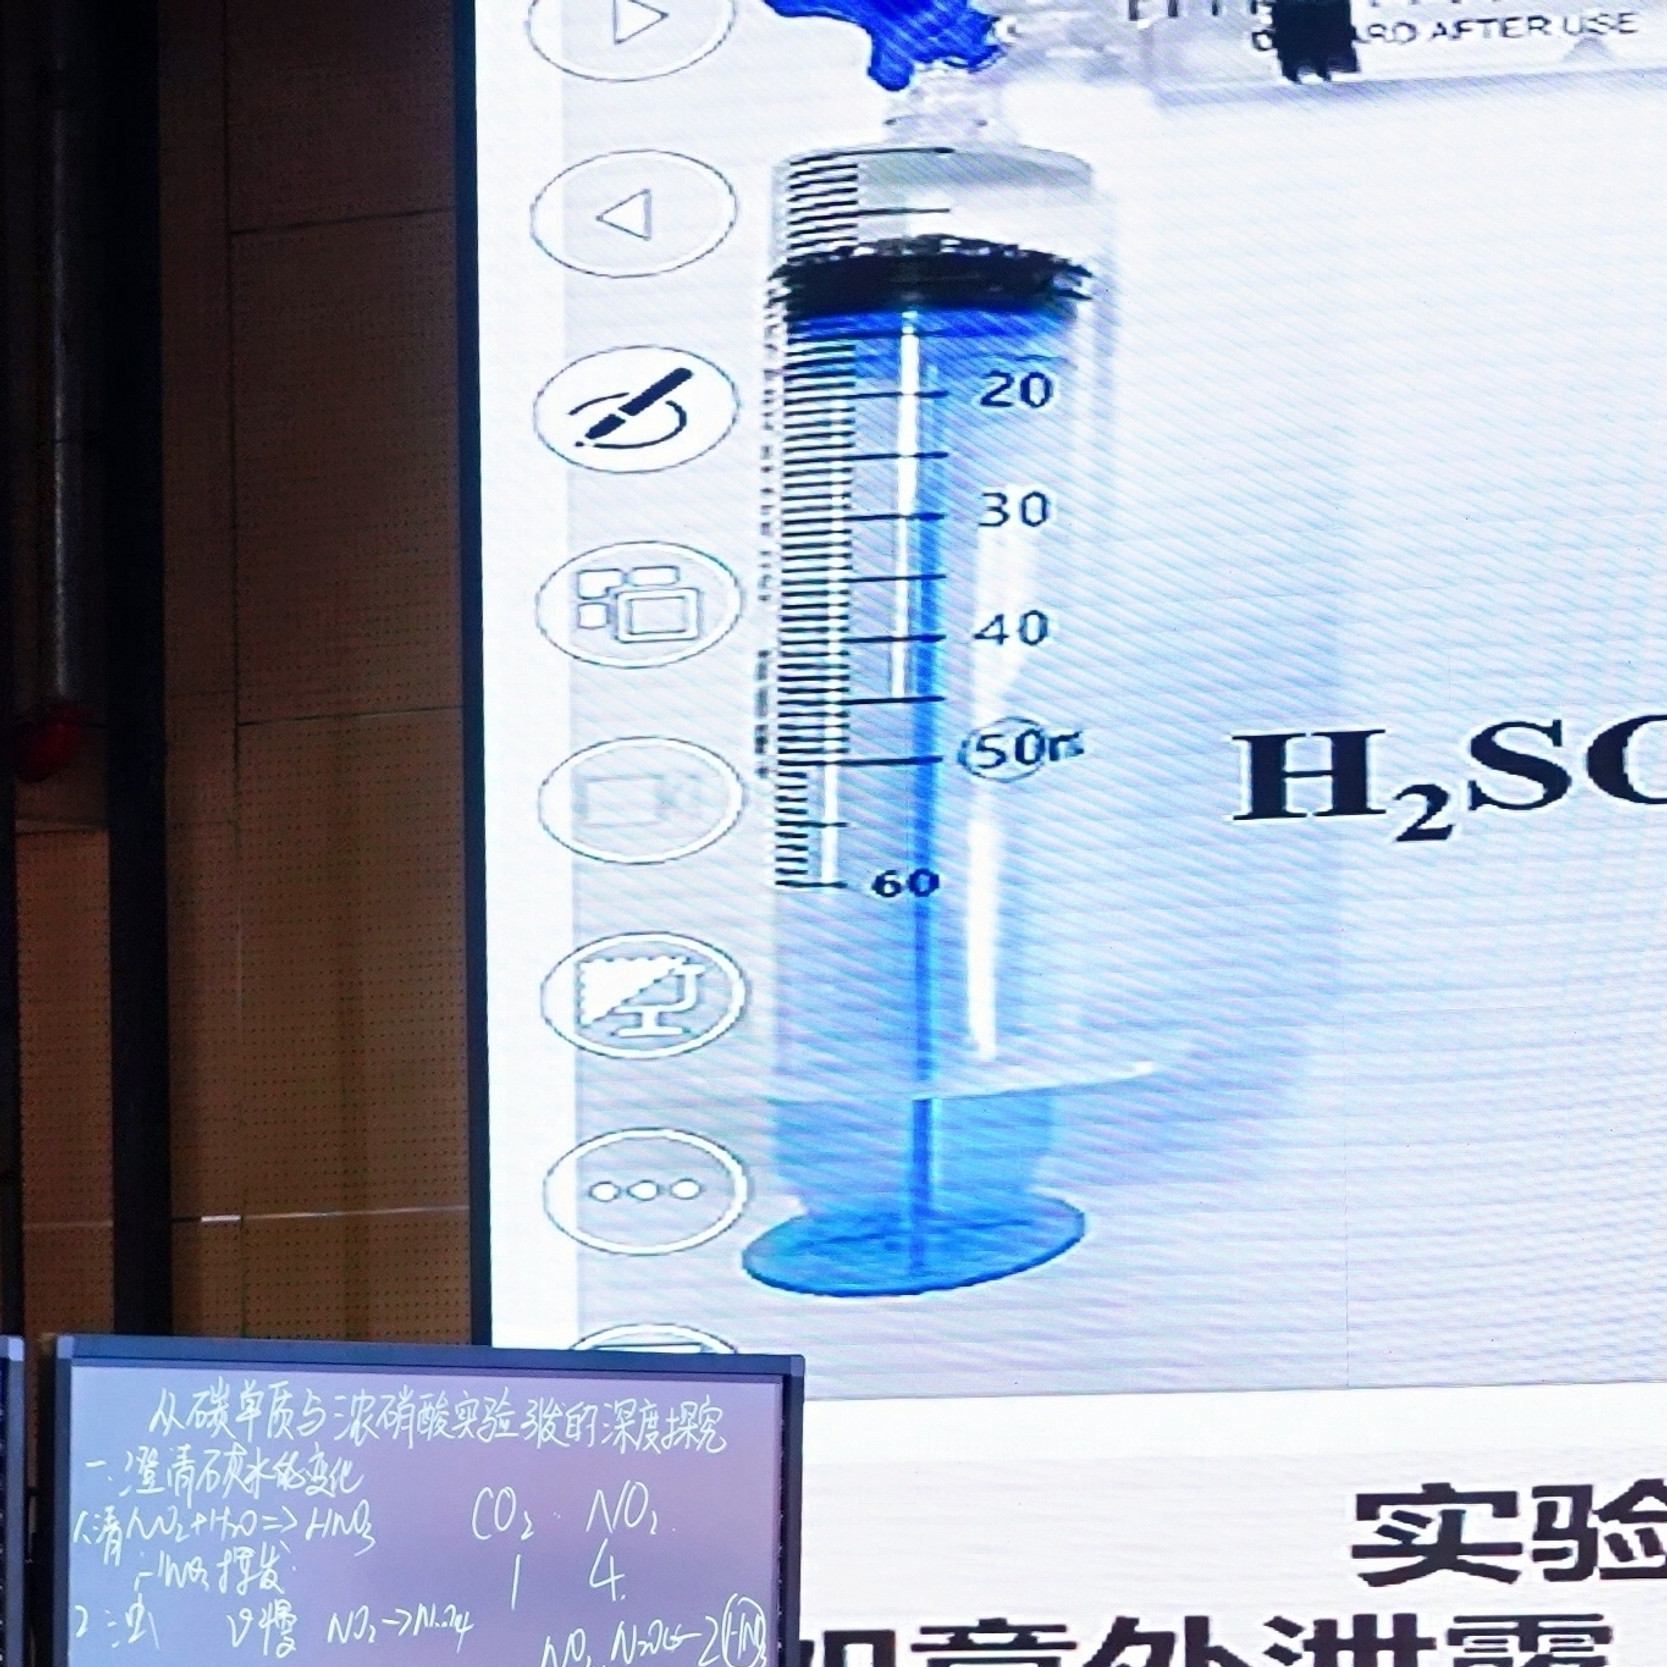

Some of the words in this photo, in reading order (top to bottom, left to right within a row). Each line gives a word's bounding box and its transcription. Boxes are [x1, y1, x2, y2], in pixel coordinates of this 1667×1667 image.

[1430, 14, 1551, 42] AFTER
[1563, 11, 1639, 36] USE
[978, 371, 1054, 408] 20
[977, 489, 1051, 528] 30
[973, 610, 1049, 646] 40
[871, 867, 940, 898] 60
